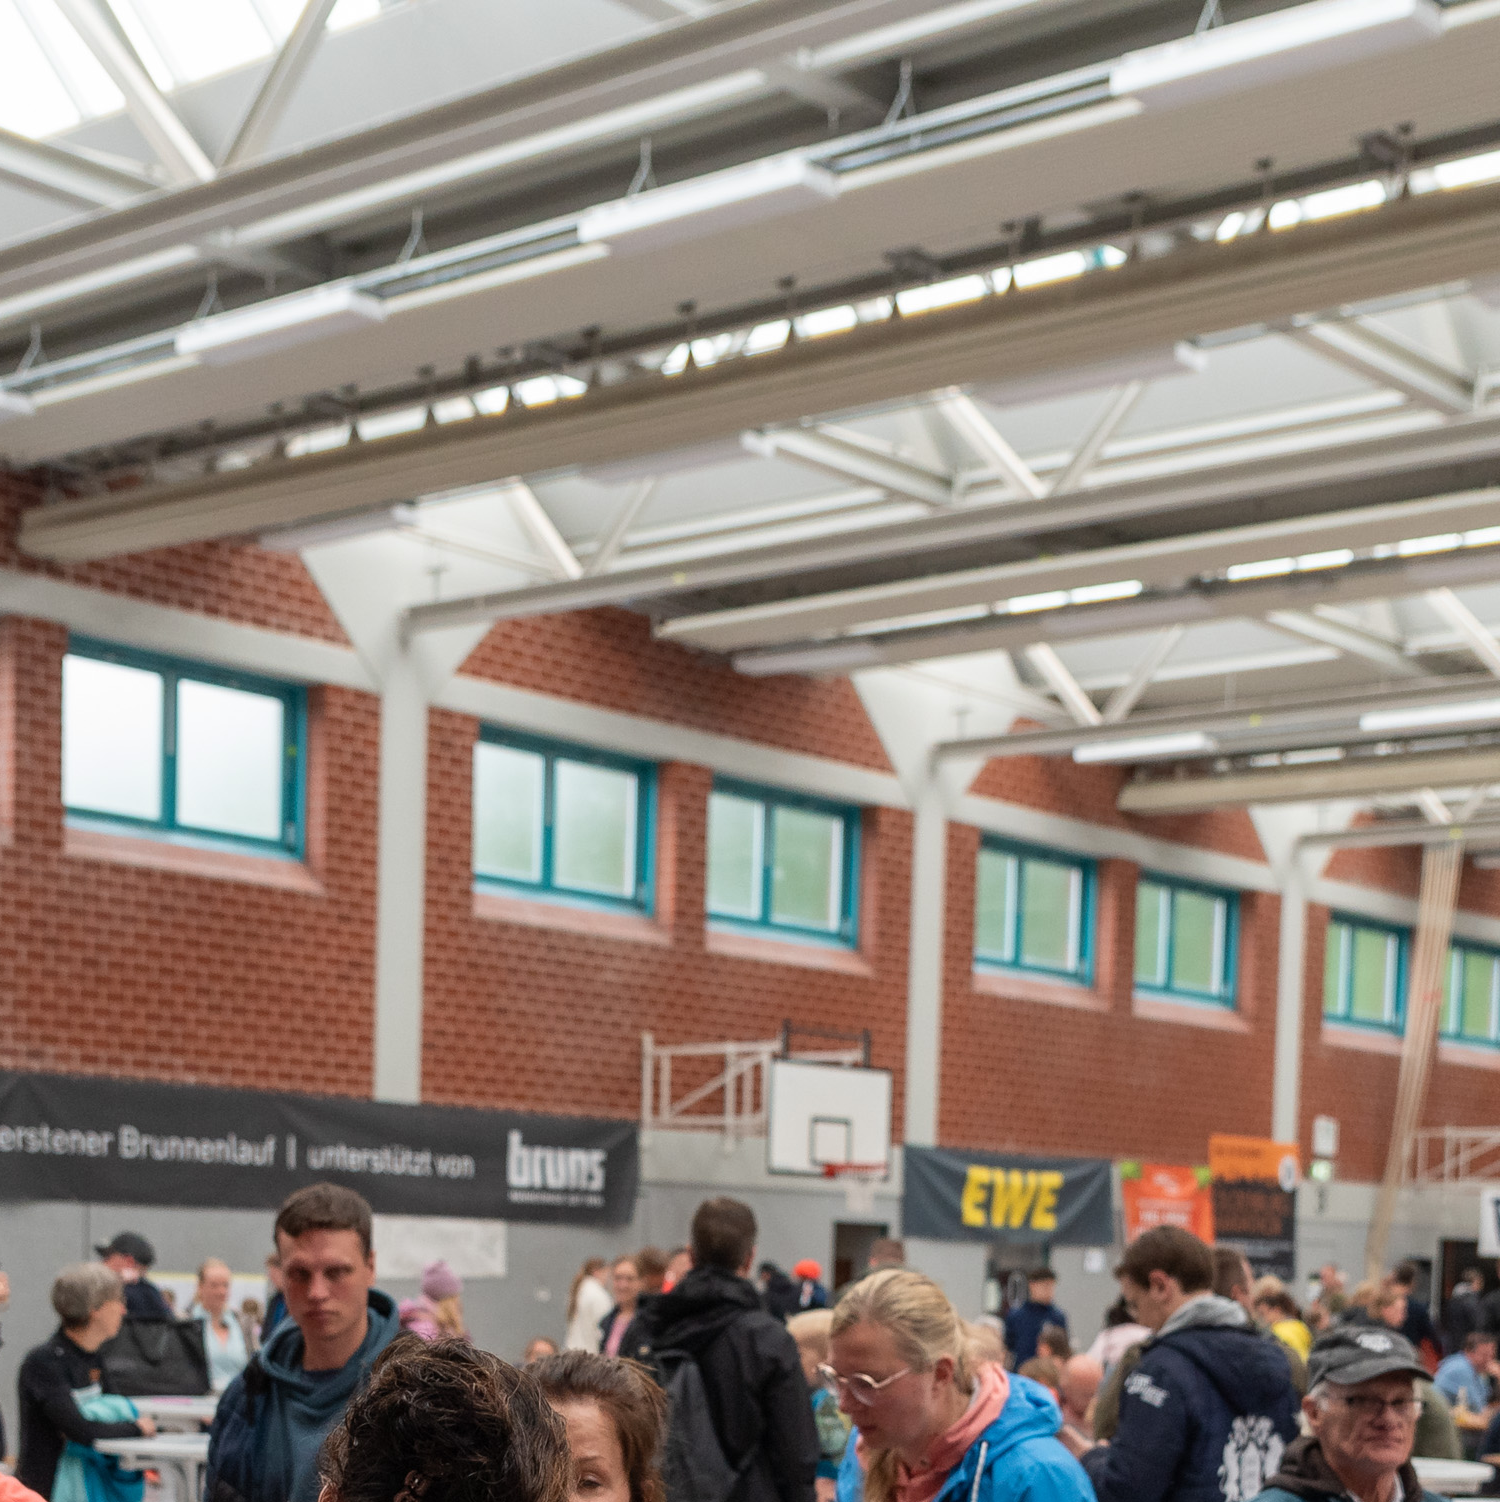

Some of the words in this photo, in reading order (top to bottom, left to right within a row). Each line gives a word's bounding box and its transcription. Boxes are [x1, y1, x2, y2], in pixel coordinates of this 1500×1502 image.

[118, 1124, 276, 1166] Brunnenlauf
[306, 1144, 434, 1176] unterstützt
[434, 1153, 476, 1179] von
[506, 1129, 607, 1191] bruns
[961, 1165, 1065, 1231] EWE
